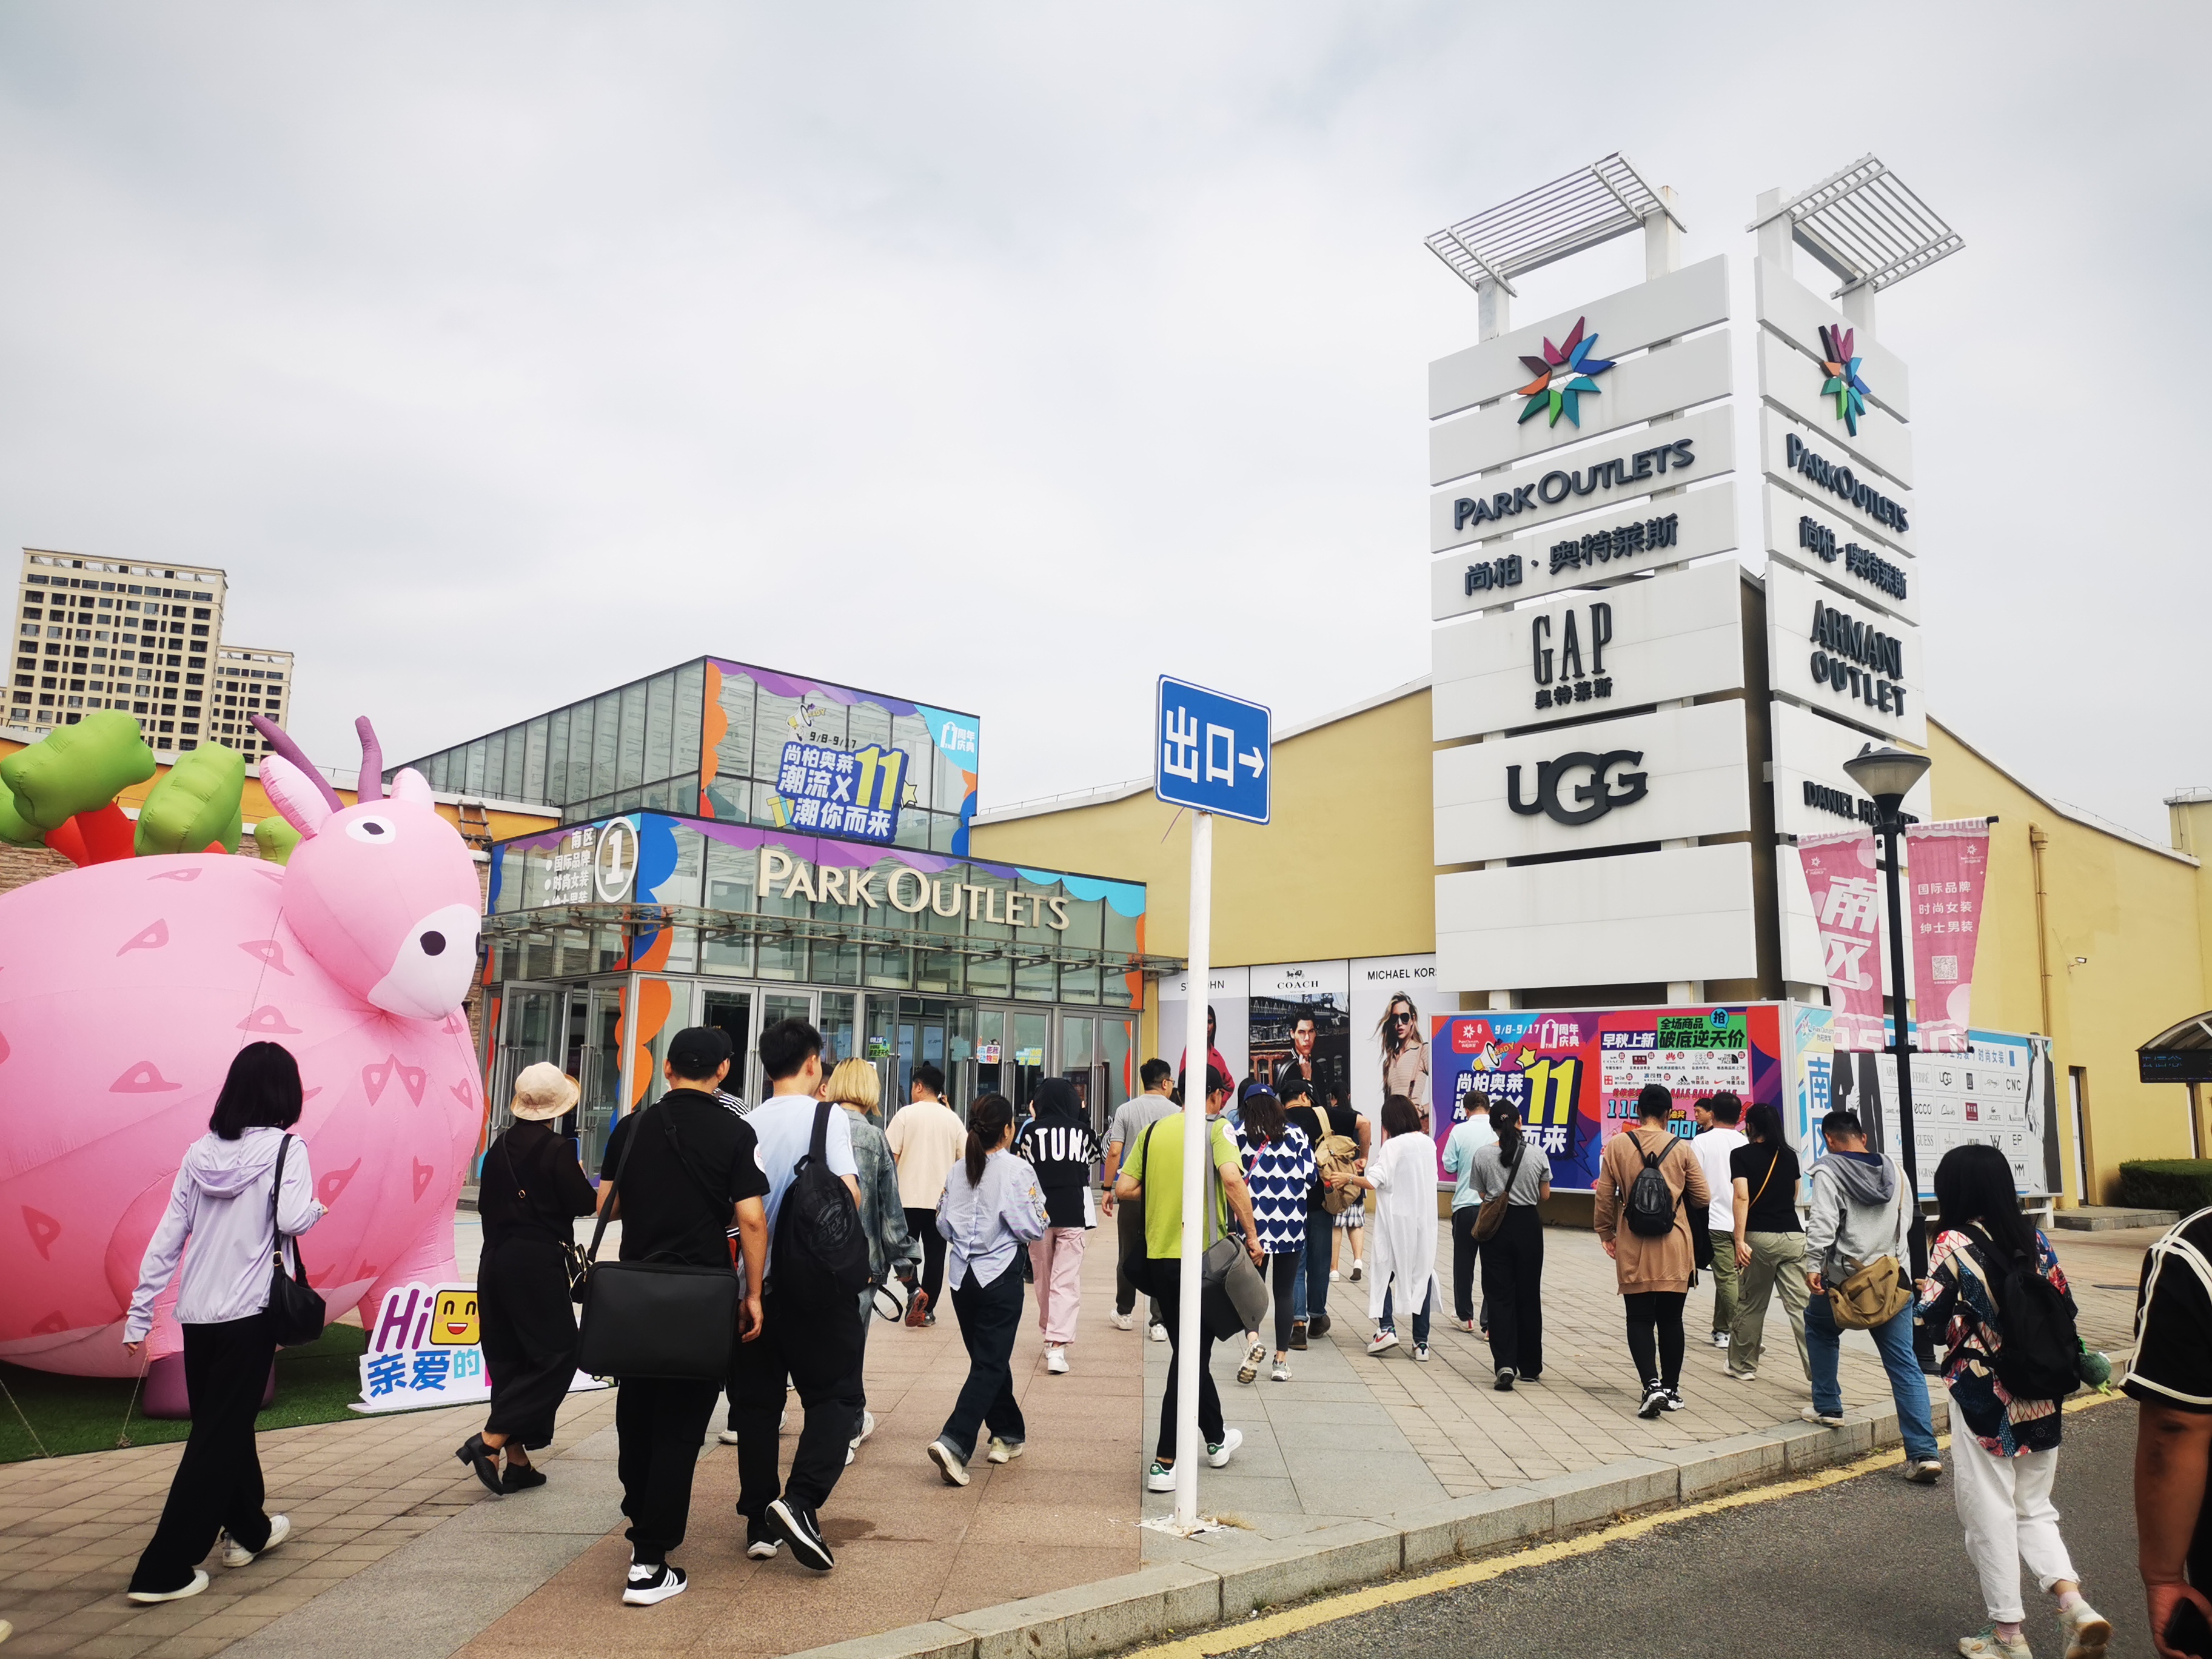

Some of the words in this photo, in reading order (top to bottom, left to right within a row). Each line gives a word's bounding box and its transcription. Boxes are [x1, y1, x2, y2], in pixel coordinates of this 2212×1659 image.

[1532, 601, 1613, 686] GAP
[1809, 599, 1905, 680] ARMANI
[1534, 677, 1614, 709] 奥特莱斯
[1810, 651, 1907, 717] OUTLET
[809, 731, 857, 749] 9/8-9/17
[958, 728, 976, 742] 周年
[957, 740, 974, 753] 庆典
[1164, 706, 1234, 787] 出口
[784, 745, 854, 774] 尚柏奥莱
[855, 746, 903, 811] 11
[1506, 749, 1649, 826] UGG
[1803, 780, 1858, 819] DANIEL
[793, 797, 891, 837] 潮你而来
[572, 828, 594, 850] 南区
[554, 850, 591, 872] 国际品牌
[552, 870, 589, 891] 时尚女装
[757, 848, 879, 908] PARK
[886, 867, 1070, 931] OUTLETS
[1918, 881, 1971, 896] 国际品牌
[1919, 901, 1972, 916] 时尚女装
[1820, 875, 1879, 990] 南区
[1920, 921, 1974, 934] 绅士男装
[1367, 969, 1410, 980] MICHAEL
[1277, 980, 1319, 990] COACH
[1660, 1017, 1703, 1030] 全场商品
[1714, 1011, 1726, 1024] 抢
[1495, 1024, 1540, 1035] 9/8-9/17
[1559, 1024, 1579, 1035] 周年
[1659, 1029, 1745, 1048] 破底逆天价
[1559, 1036, 1580, 1047] 庆典
[1602, 1033, 1655, 1048] 早秋上新
[1456, 1073, 1524, 1093] 尚柏奥莱
[1939, 1071, 1952, 1086] UGG
[2006, 1079, 2021, 1091] CNC
[1524, 1059, 1575, 1124] 11
[1916, 1134, 1934, 1147] GUESS
[375, 1289, 433, 1353] Hi
[367, 1349, 480, 1398] 亲爱的
